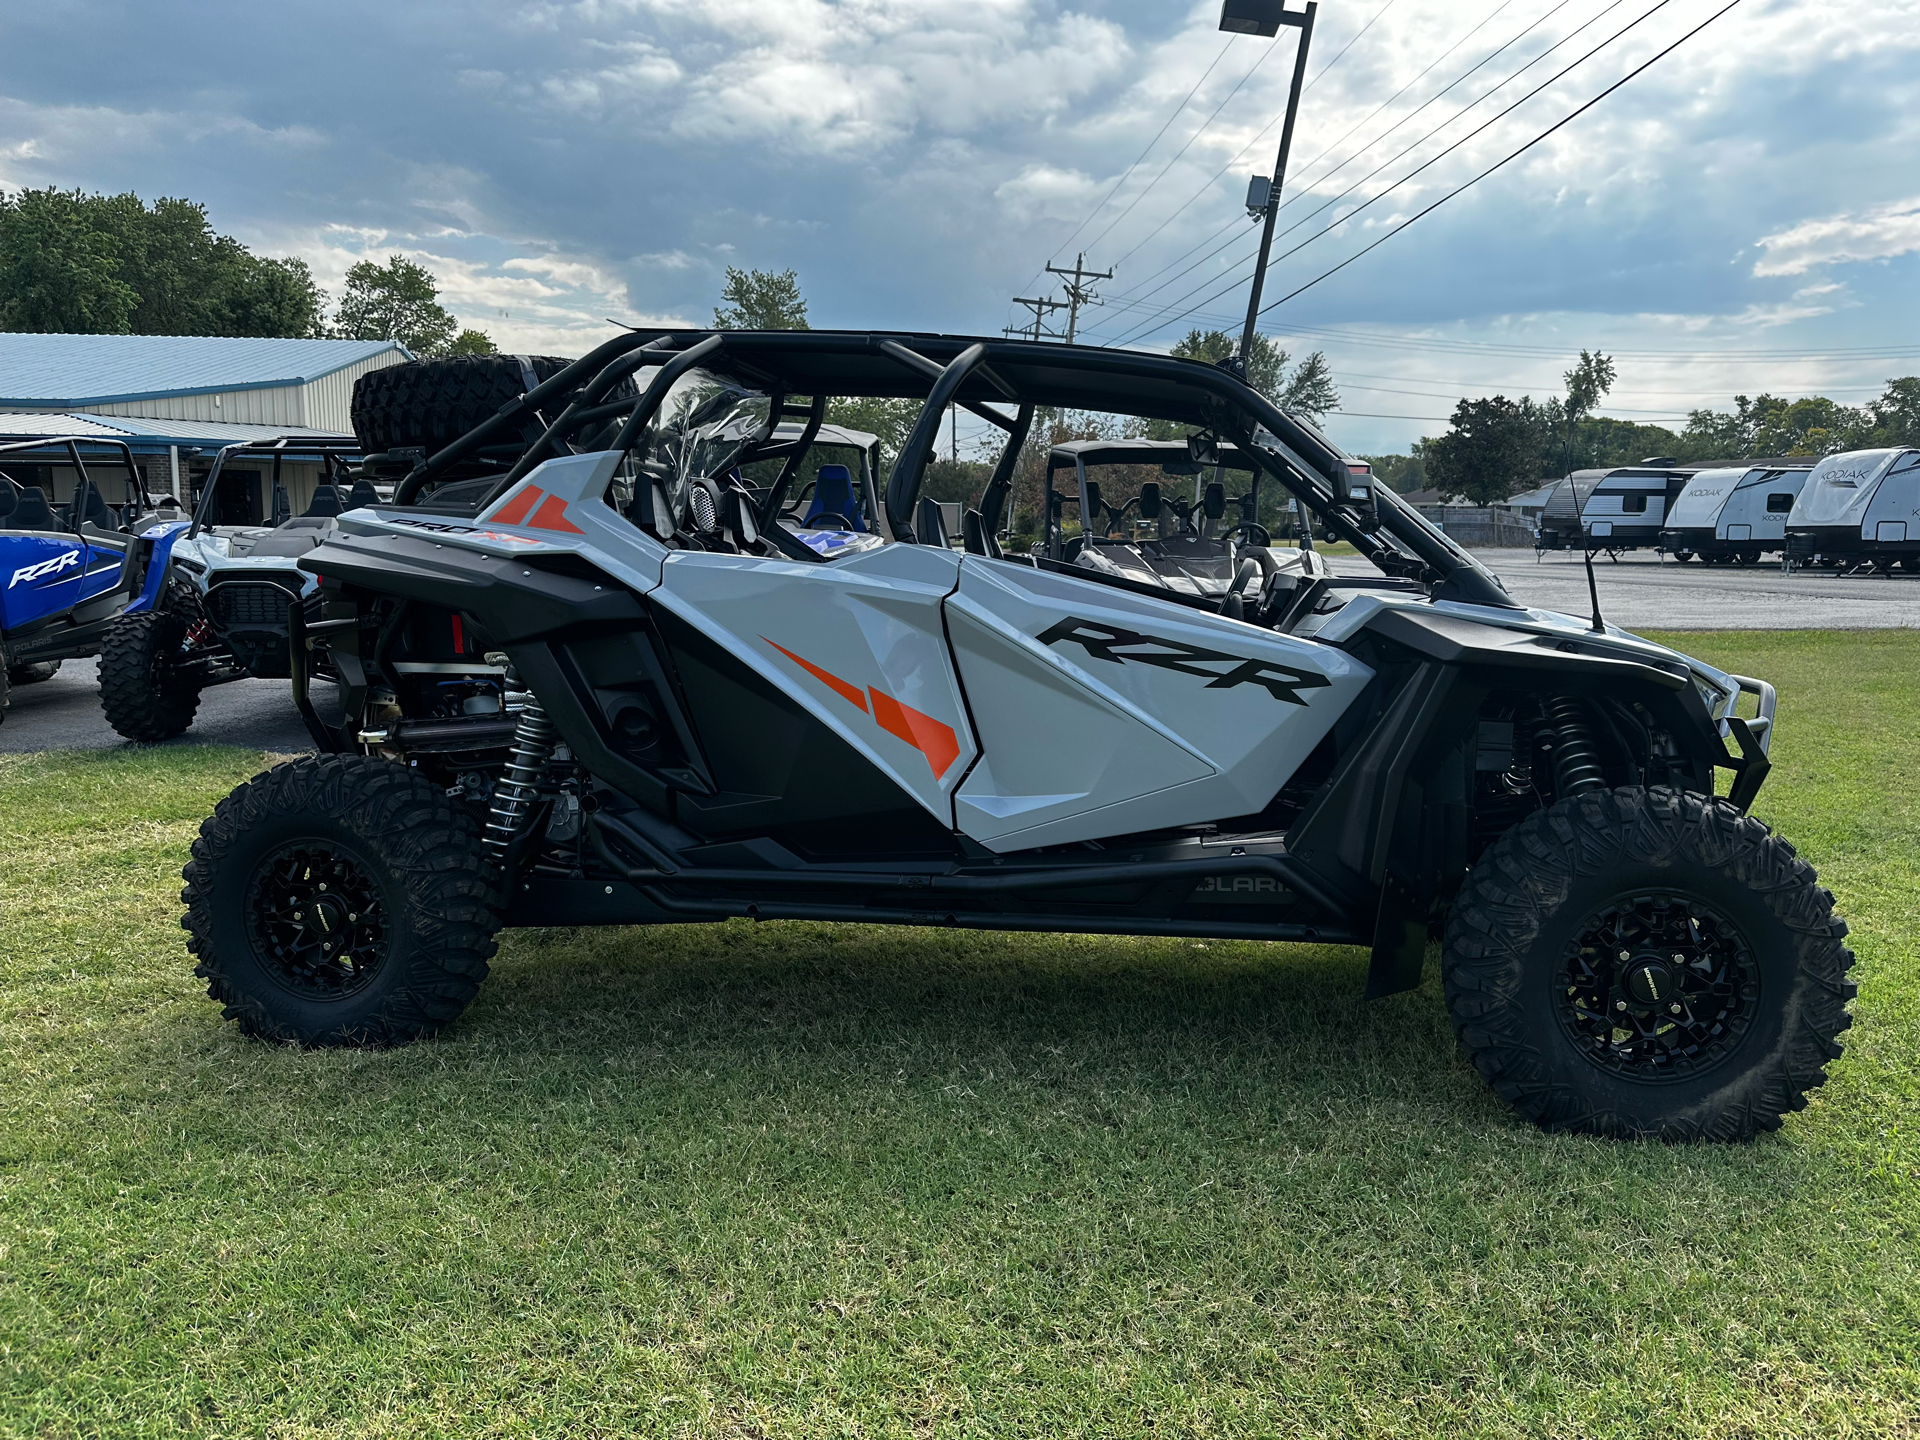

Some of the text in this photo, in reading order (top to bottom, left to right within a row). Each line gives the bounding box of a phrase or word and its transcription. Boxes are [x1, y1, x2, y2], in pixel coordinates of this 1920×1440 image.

[1820, 469, 1869, 480] KODIAK
[1688, 488, 1723, 497] KODIAK
[387, 519, 541, 545] PRO XP
[8, 549, 80, 590] RZR
[14, 637, 52, 652] POLARIS
[1035, 616, 1332, 707] RZR
